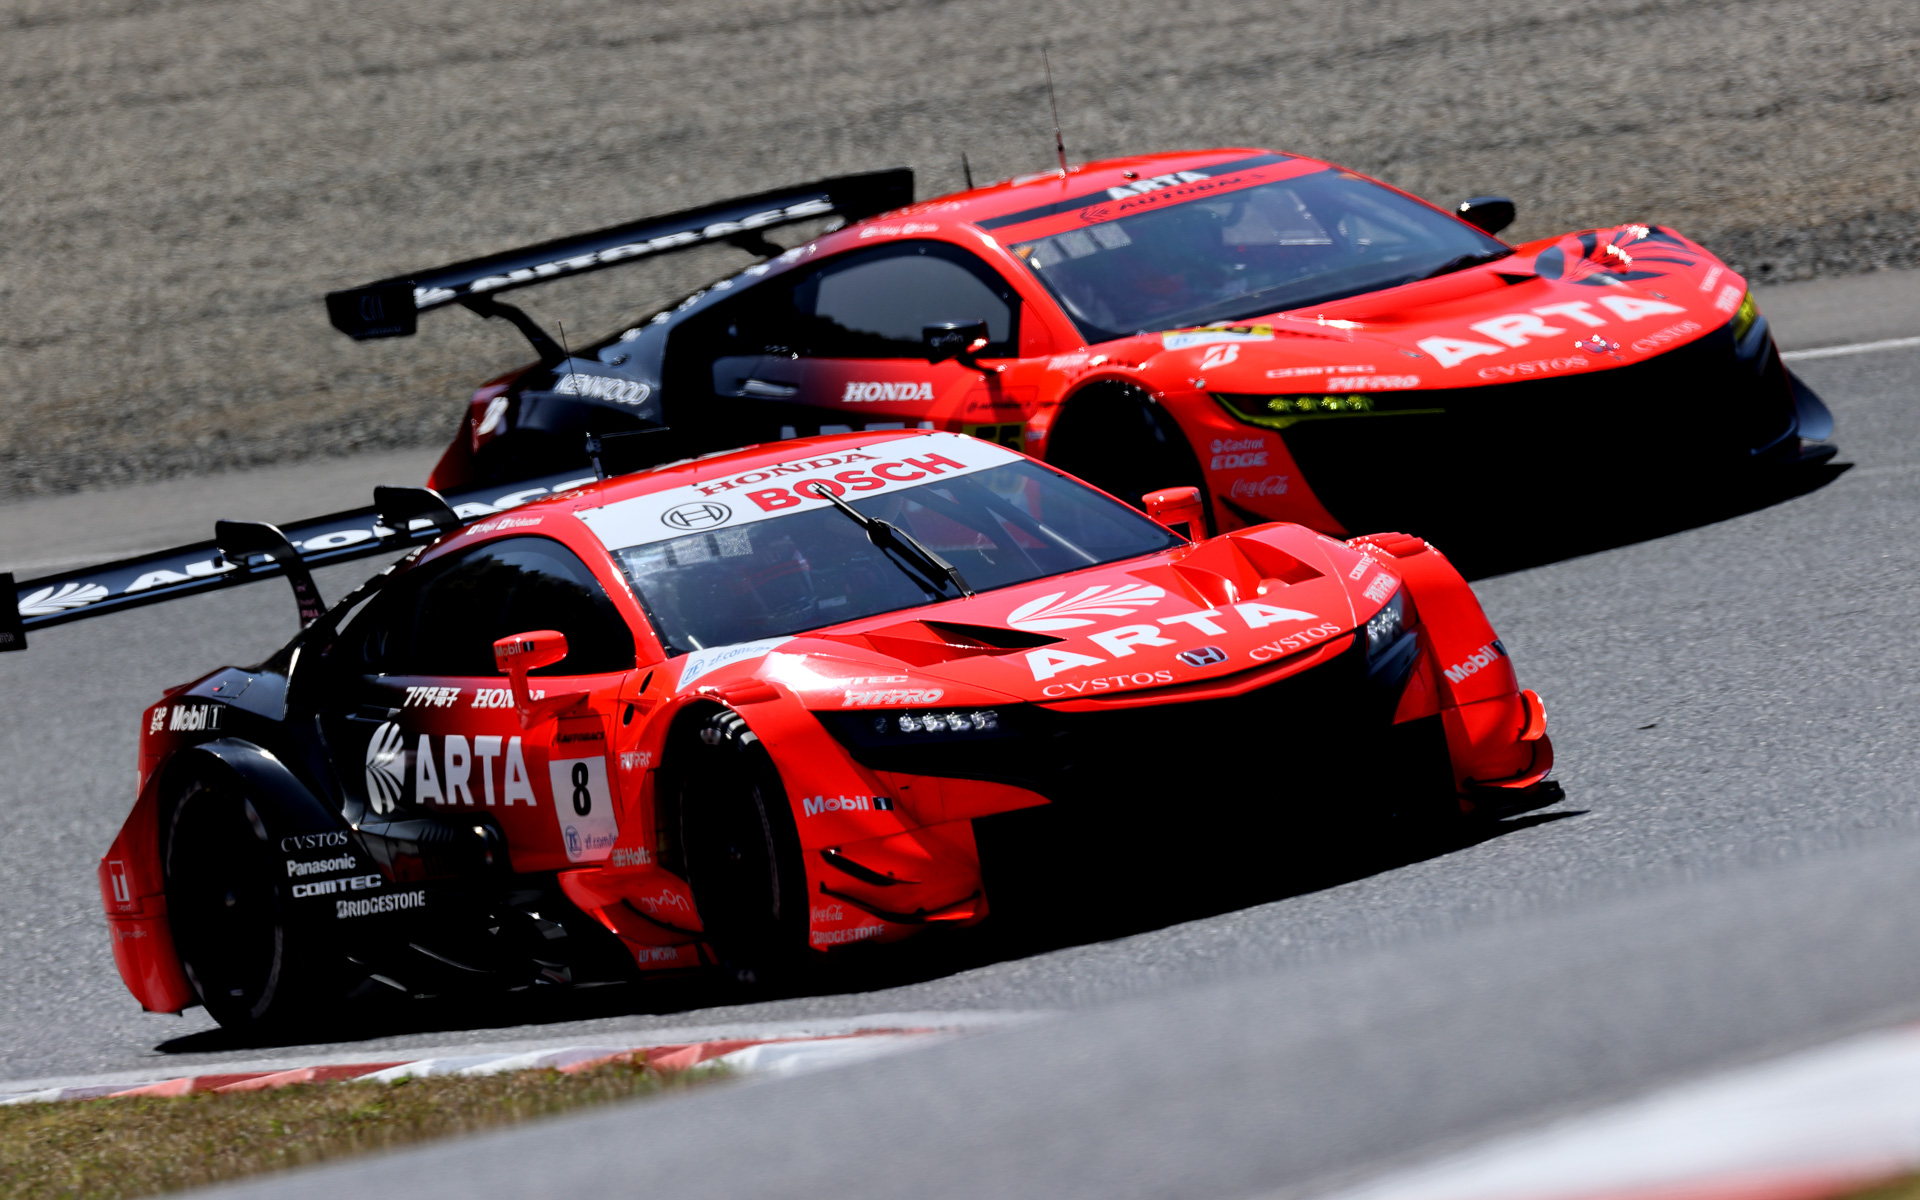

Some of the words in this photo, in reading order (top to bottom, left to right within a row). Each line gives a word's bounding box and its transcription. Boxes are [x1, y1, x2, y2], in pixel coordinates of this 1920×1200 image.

[1106, 171, 1210, 200] ARTA
[1417, 295, 1688, 369] ARTA
[1631, 320, 1702, 353] CVSTOS
[1265, 365, 1376, 379] COMTEC
[1477, 355, 1589, 379] CVSTOS
[553, 373, 650, 404] KENWOOD
[842, 382, 934, 402] HONDA
[1210, 451, 1269, 470] EDGE
[693, 453, 882, 497] HONDA
[745, 453, 968, 512] BOSCH
[495, 643, 521, 657] Mobil
[1025, 603, 1319, 682] ARTA
[1249, 622, 1341, 661] CVSTOS
[1444, 645, 1498, 683] Mobil
[1042, 670, 1174, 697] CVSTOS
[153, 706, 167, 721] CAP
[169, 704, 208, 731] Mobil
[416, 734, 537, 806] ARTA
[571, 762, 592, 816] 8
[803, 795, 869, 817] Mobil
[281, 830, 348, 852] CVSTOS
[286, 853, 356, 877] Panasonic
[624, 847, 651, 866] Holts
[292, 874, 381, 898] COMTEC
[336, 890, 426, 919] BRIDGESTONE
[812, 924, 885, 944] BRIDGESTONE
